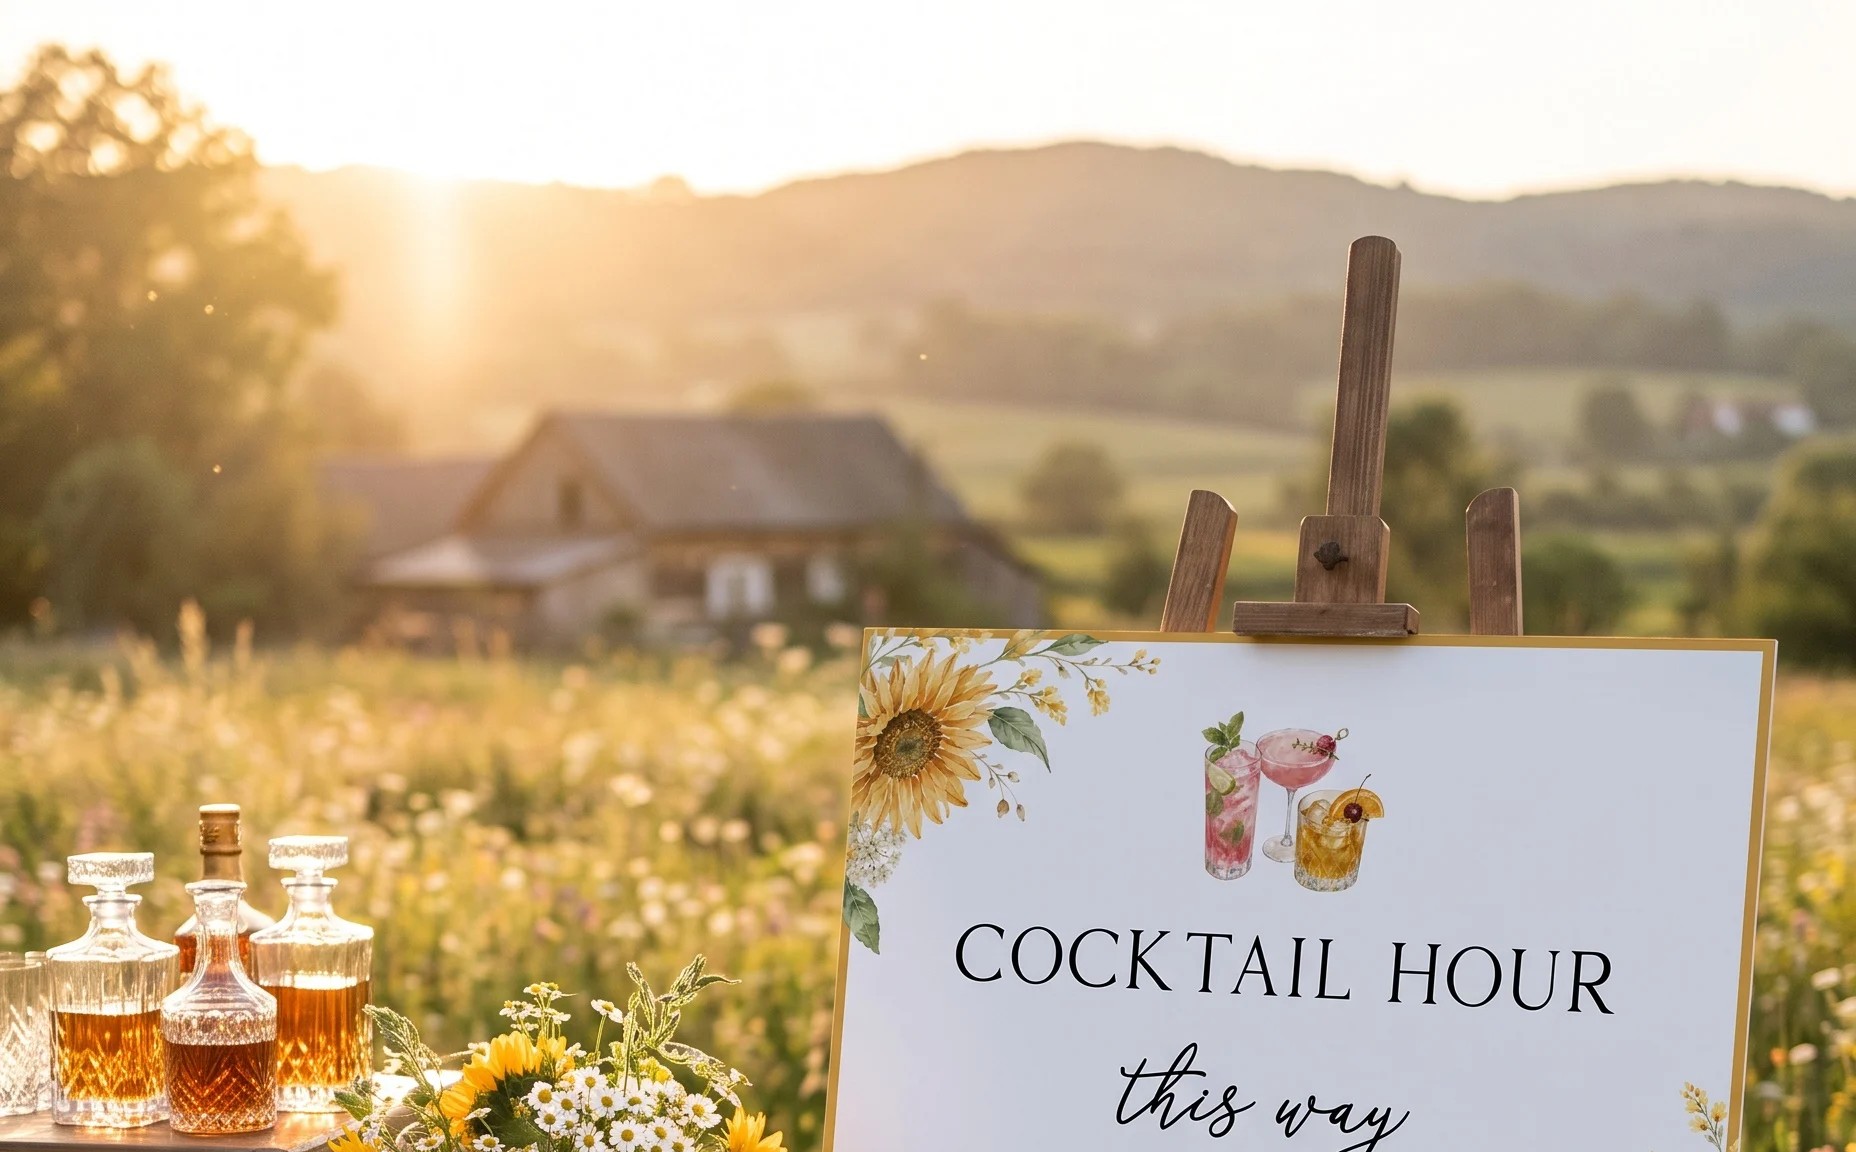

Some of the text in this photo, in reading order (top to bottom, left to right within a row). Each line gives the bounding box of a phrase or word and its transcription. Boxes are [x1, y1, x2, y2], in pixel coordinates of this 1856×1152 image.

[955, 923, 1615, 1015] COCKTAIL HOUR
[1115, 1042, 1257, 1139] this
